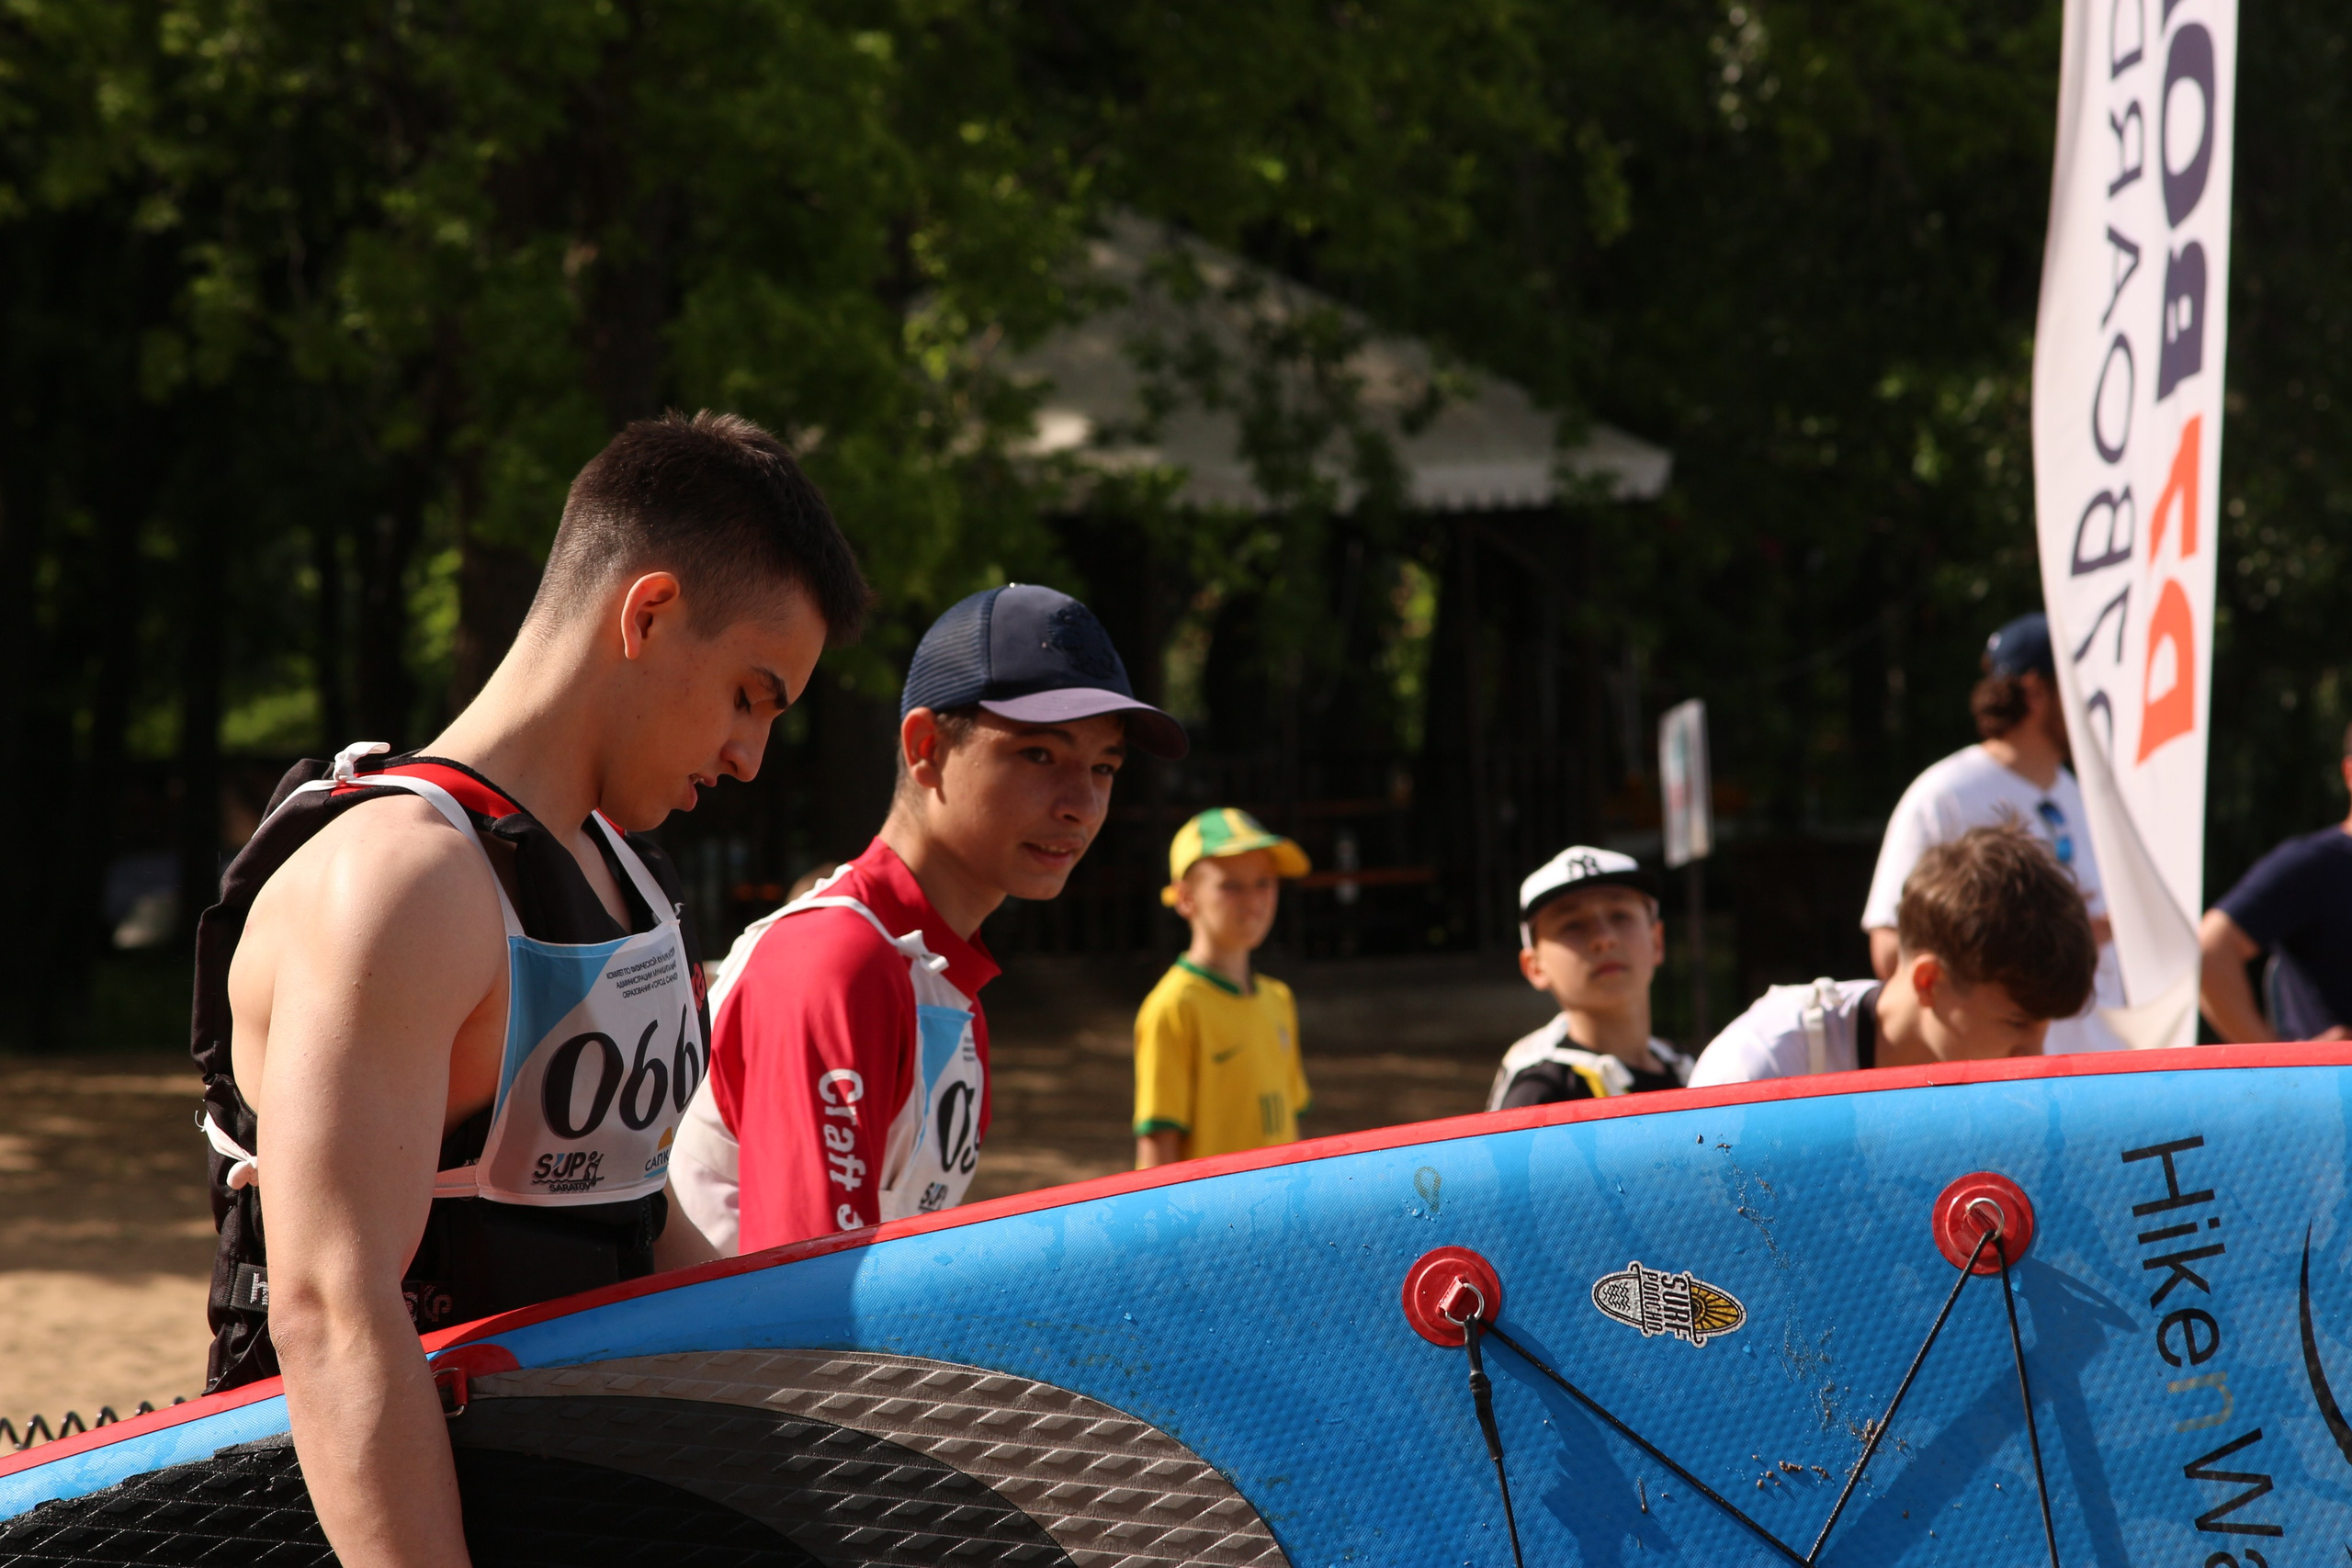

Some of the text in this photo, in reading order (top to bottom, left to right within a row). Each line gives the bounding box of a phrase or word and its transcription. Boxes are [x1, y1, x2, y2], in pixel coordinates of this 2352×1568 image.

[541, 1003, 699, 1140] 066
[819, 1068, 866, 1192] Craft
[534, 1152, 587, 1179] SUP
[549, 1182, 591, 1193] SARATOV
[1661, 1274, 1692, 1338] SURF
